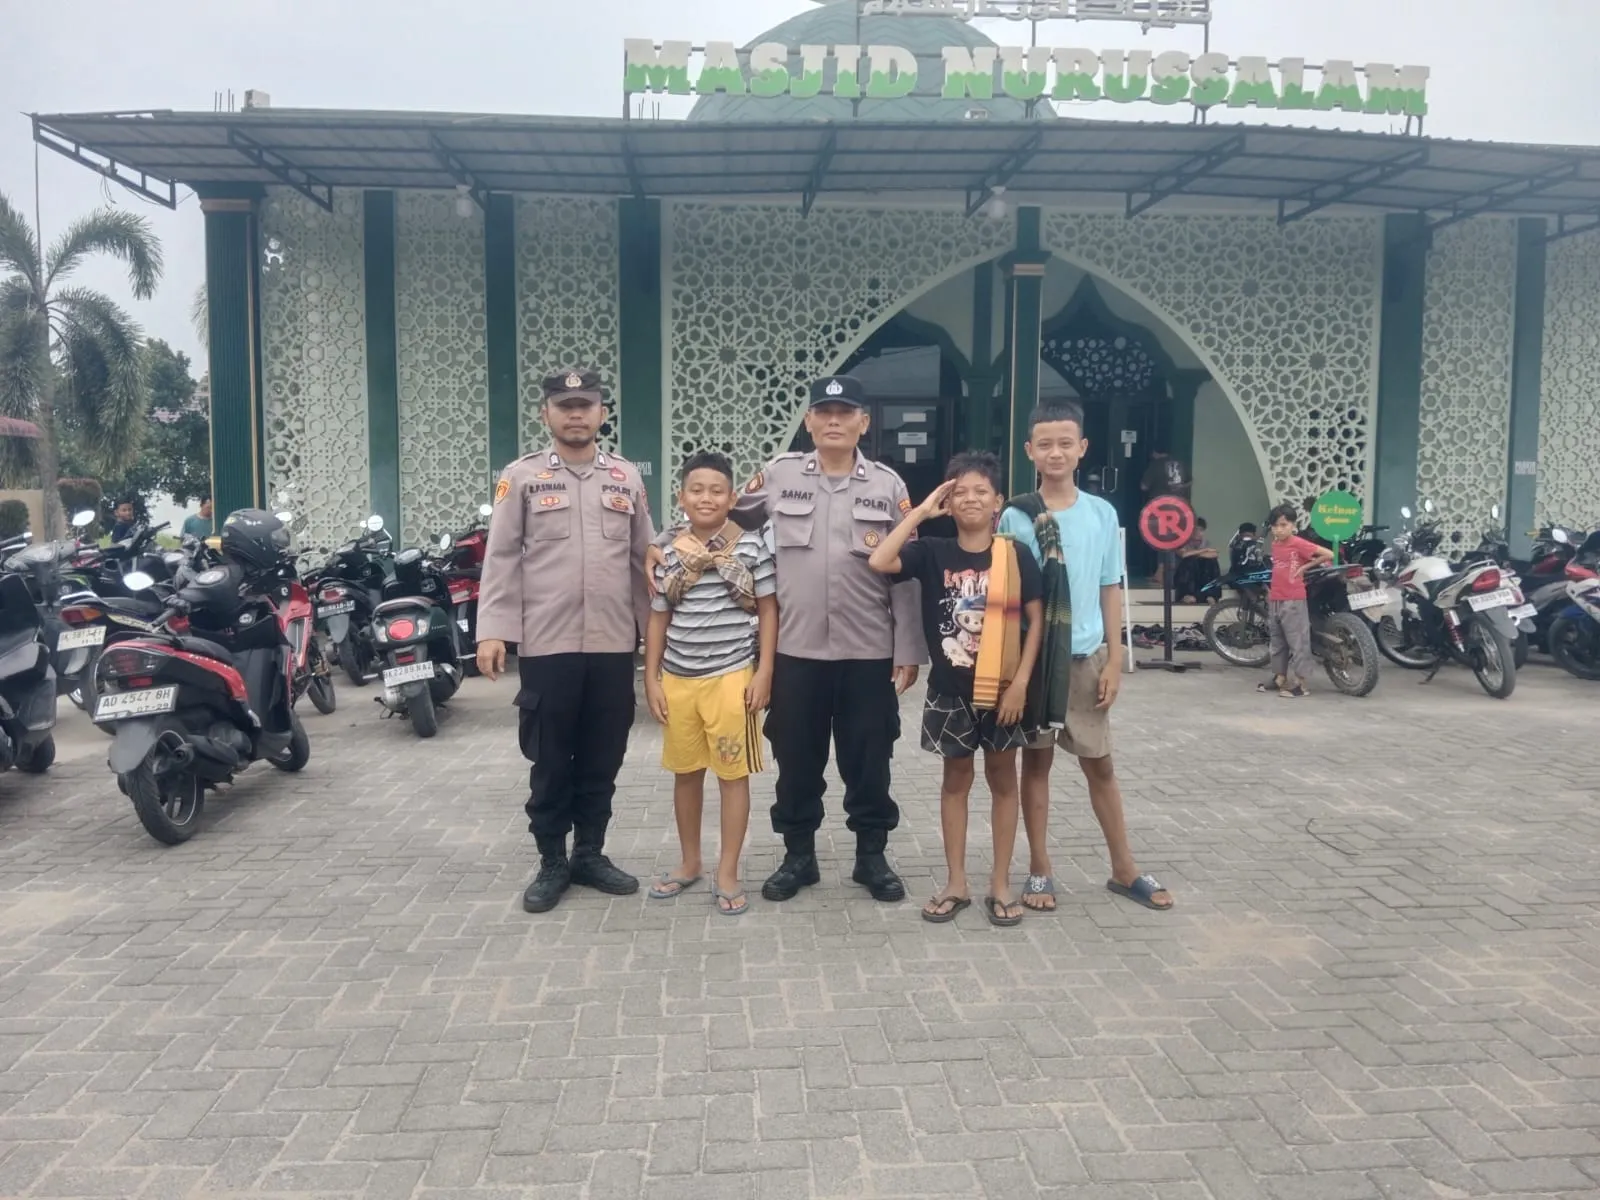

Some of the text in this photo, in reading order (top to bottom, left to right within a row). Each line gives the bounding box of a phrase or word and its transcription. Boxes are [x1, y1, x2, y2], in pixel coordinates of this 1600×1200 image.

[624, 38, 1430, 115] MASJID NURUSSALAM
[602, 484, 630, 496] POLRI
[781, 490, 814, 500] SAHAT
[855, 497, 888, 512] POLRI
[102, 697, 117, 708] AD
[121, 691, 151, 704] 4547
